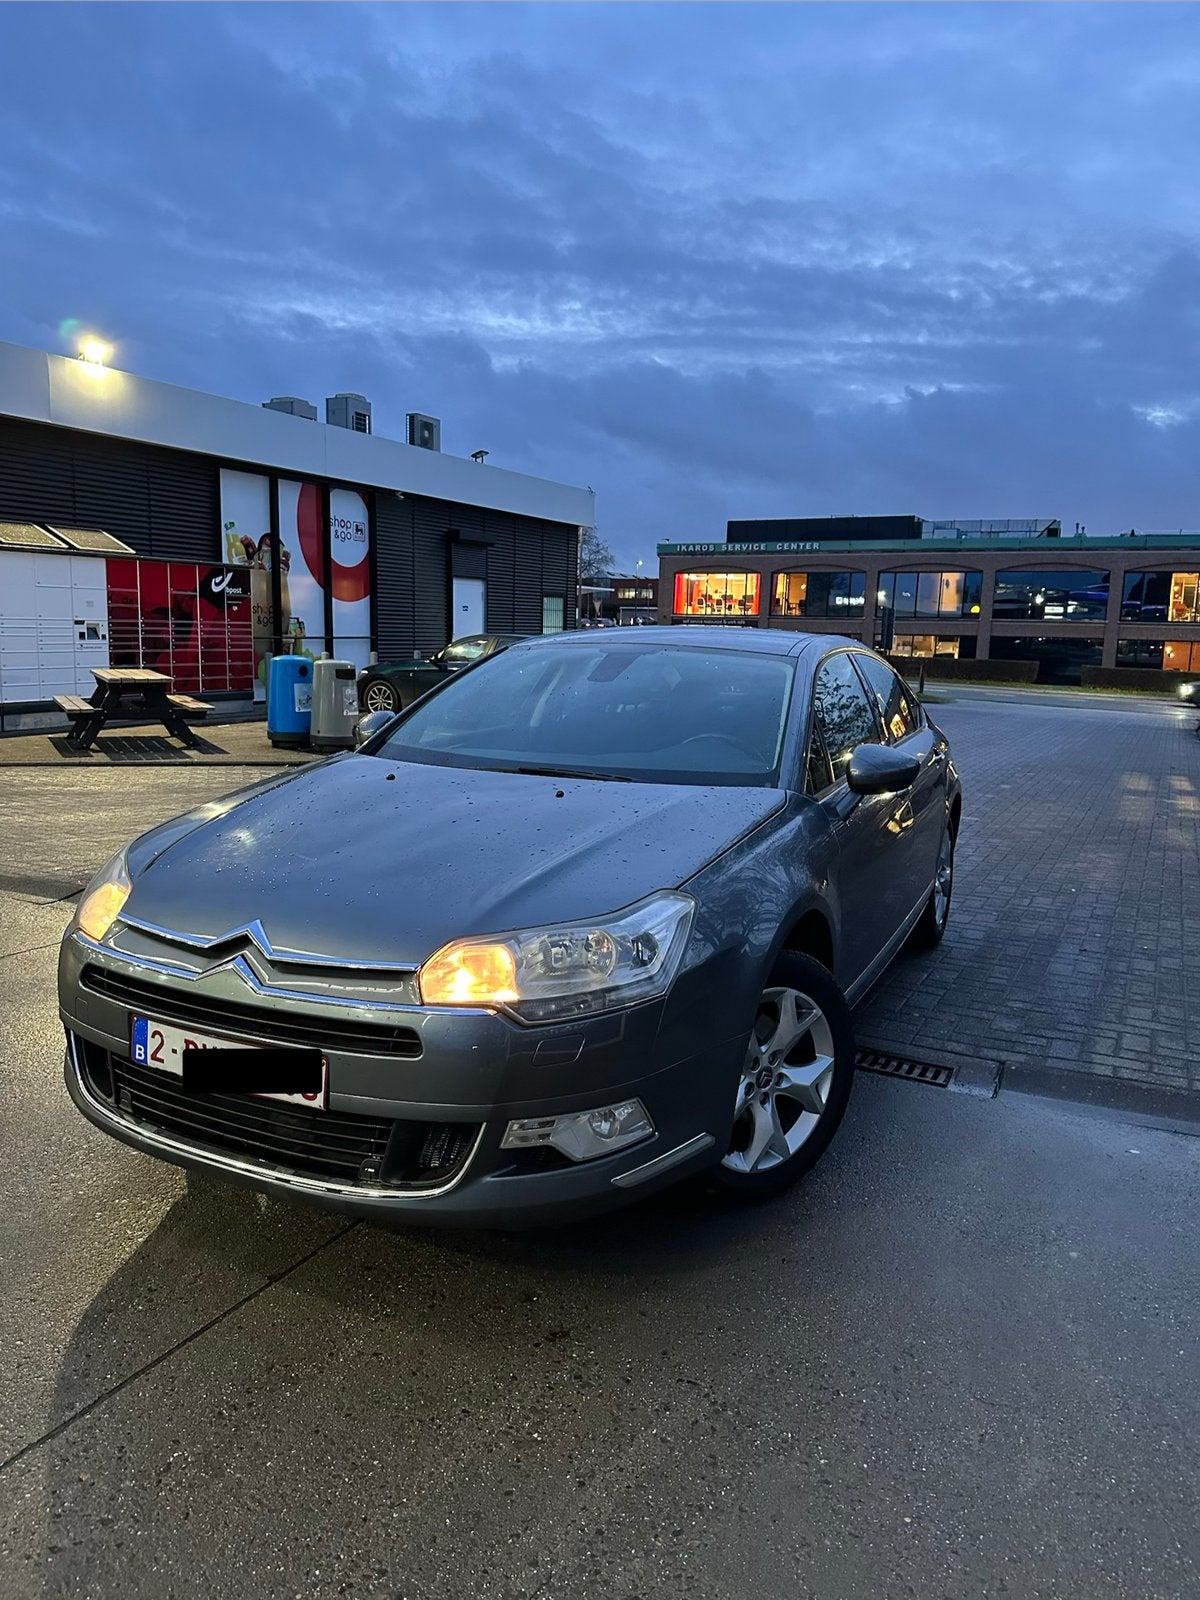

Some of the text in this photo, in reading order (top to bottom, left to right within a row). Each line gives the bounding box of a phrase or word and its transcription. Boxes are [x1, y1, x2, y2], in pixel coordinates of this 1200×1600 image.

[330, 515, 351, 531] shop
[335, 529, 352, 542] &go
[677, 542, 820, 552] IKAROS SERVICE CENTER
[225, 586, 242, 595] bpost
[135, 1044, 145, 1060] B
